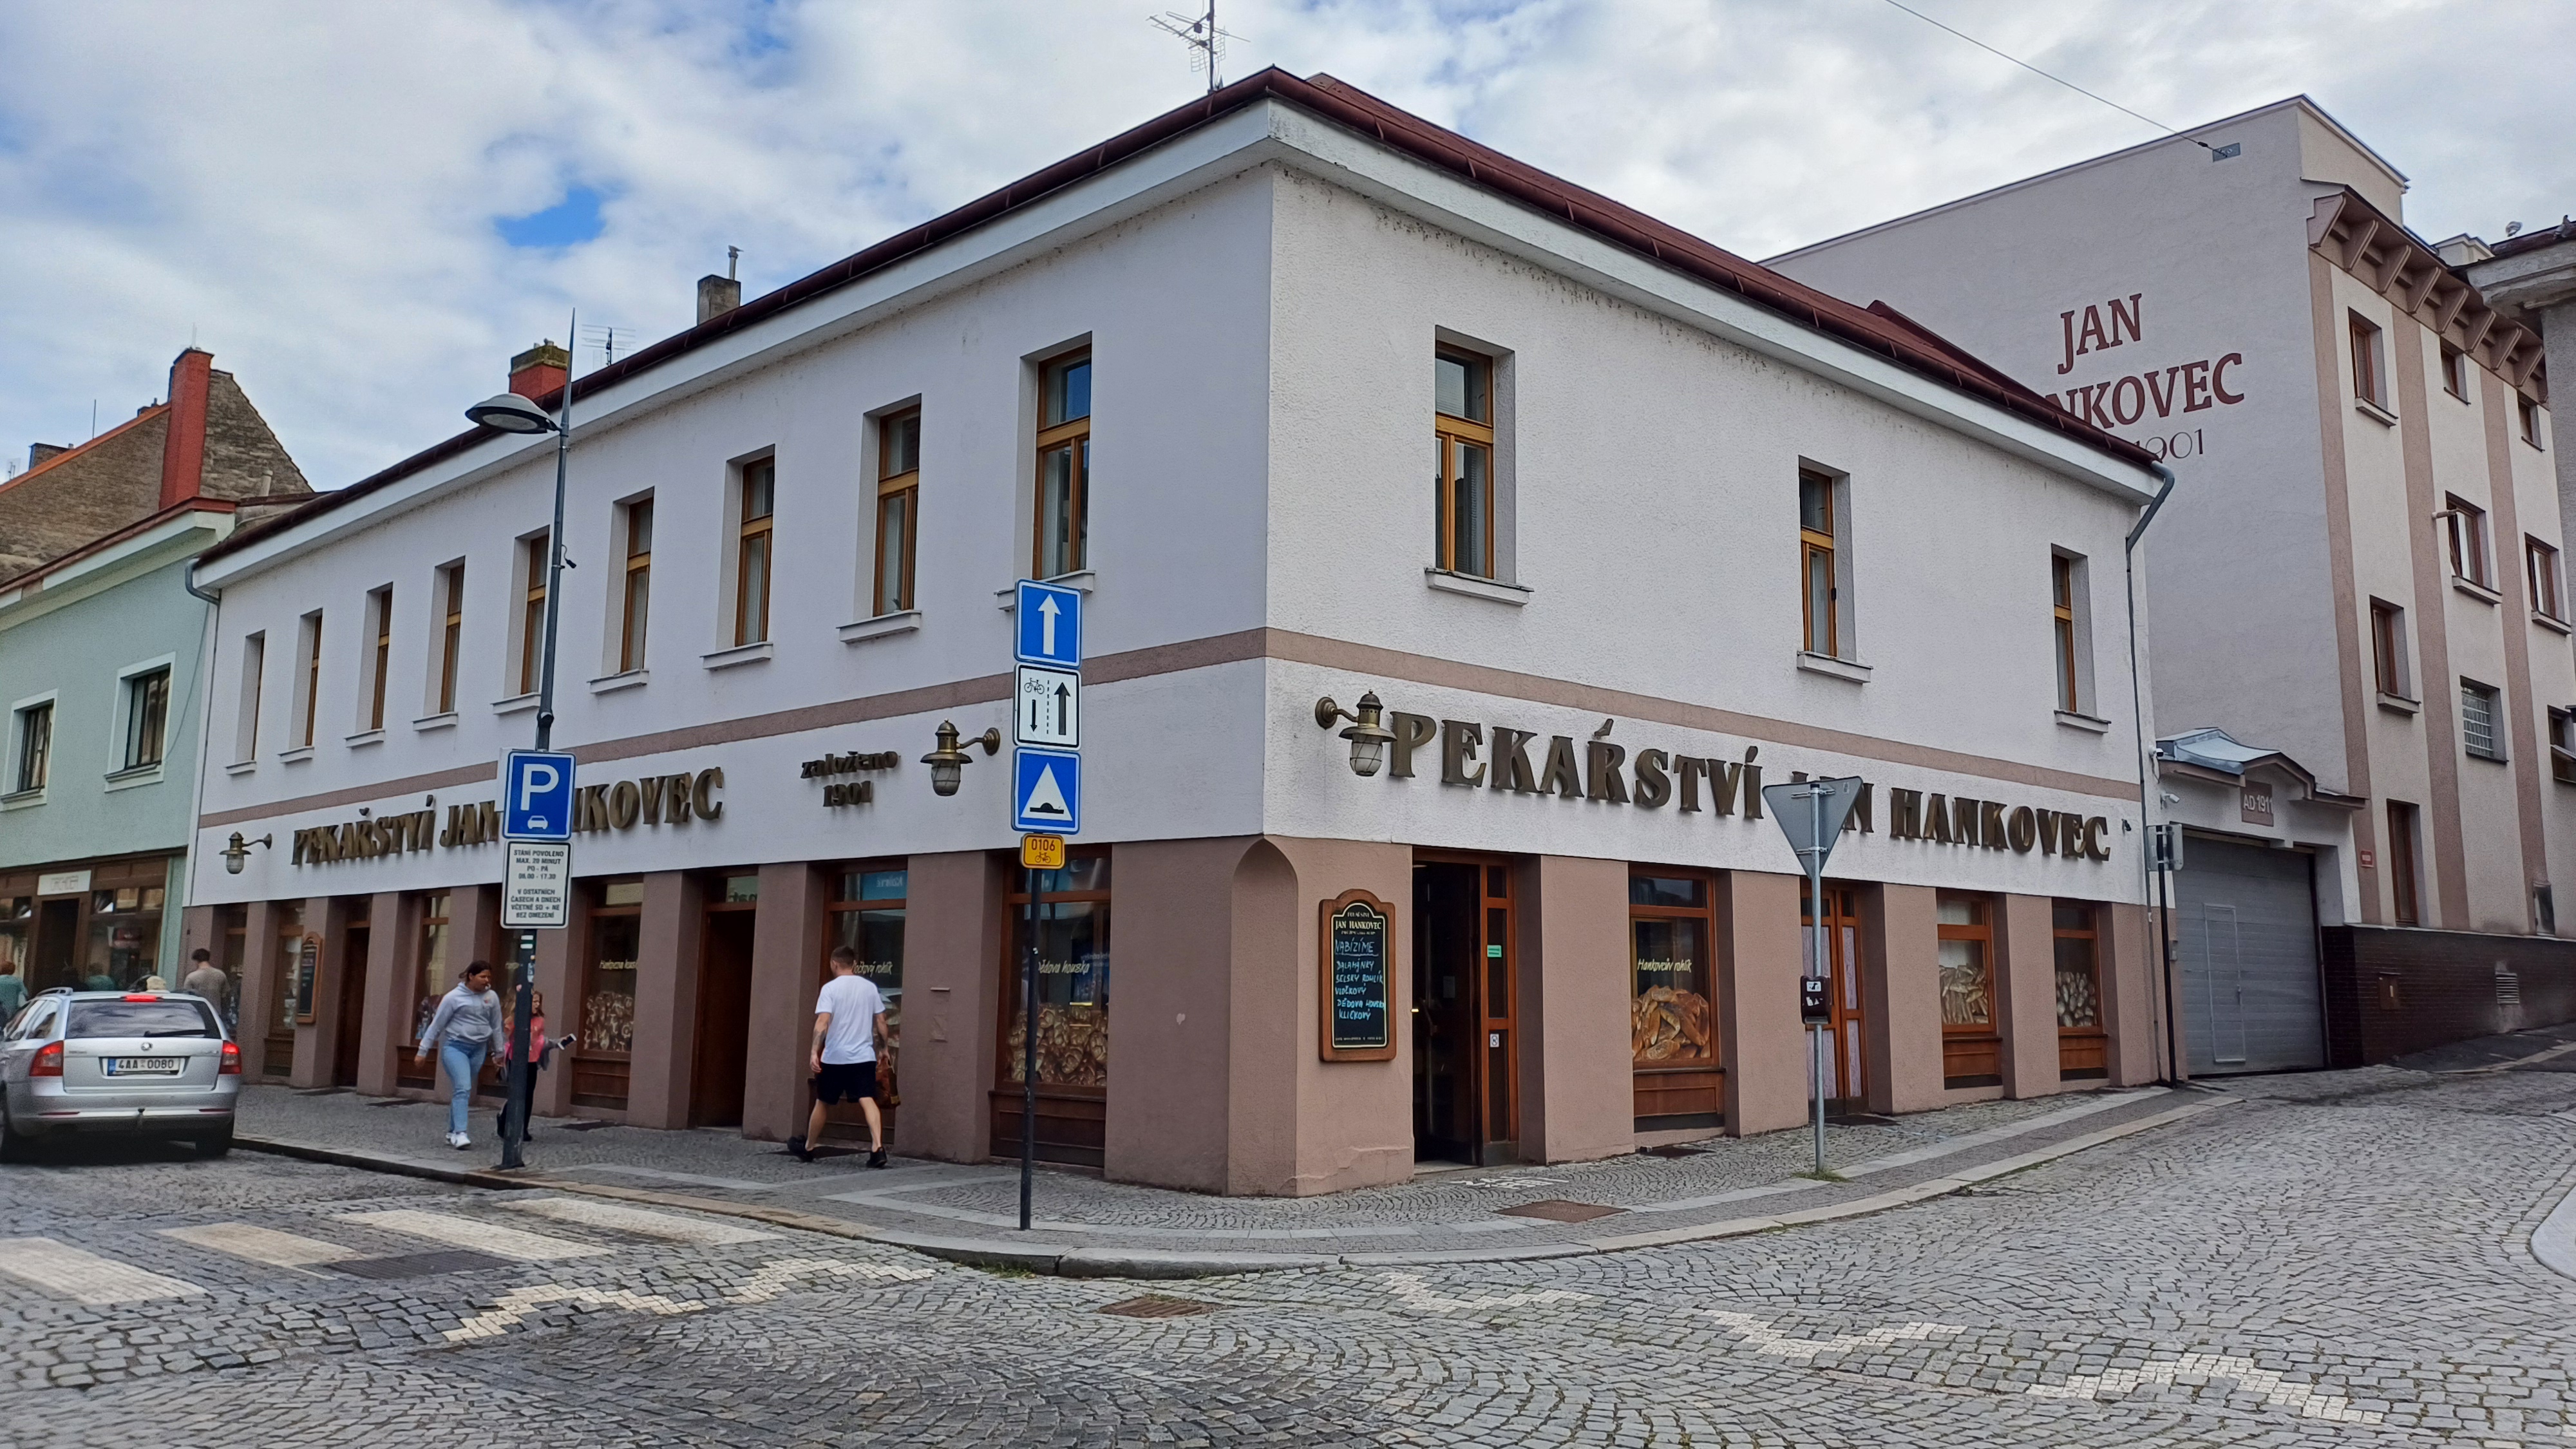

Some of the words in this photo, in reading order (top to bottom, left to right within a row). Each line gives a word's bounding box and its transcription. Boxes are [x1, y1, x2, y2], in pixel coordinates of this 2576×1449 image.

[2058, 293, 2142, 375] JAN
[2045, 352, 2245, 429] NKOVEC
[2136, 428, 2204, 462] 901
[800, 751, 898, 779] založeno
[1389, 711, 1764, 820] PEKAŘSTVÍ
[520, 763, 559, 811] P
[823, 781, 871, 808] 1901
[290, 794, 436, 866] PEKAŘSTVÍ
[439, 800, 500, 848] JAN
[573, 766, 724, 833] KOVEC
[1890, 787, 2110, 862] HANKOVEC
[1032, 838, 1056, 851] 0106
[1335, 920, 1347, 930] JAN
[1349, 920, 1382, 930] HANKOVEC
[1334, 937, 1375, 954] NABÍZÍME
[118, 1059, 138, 1069] 4AA
